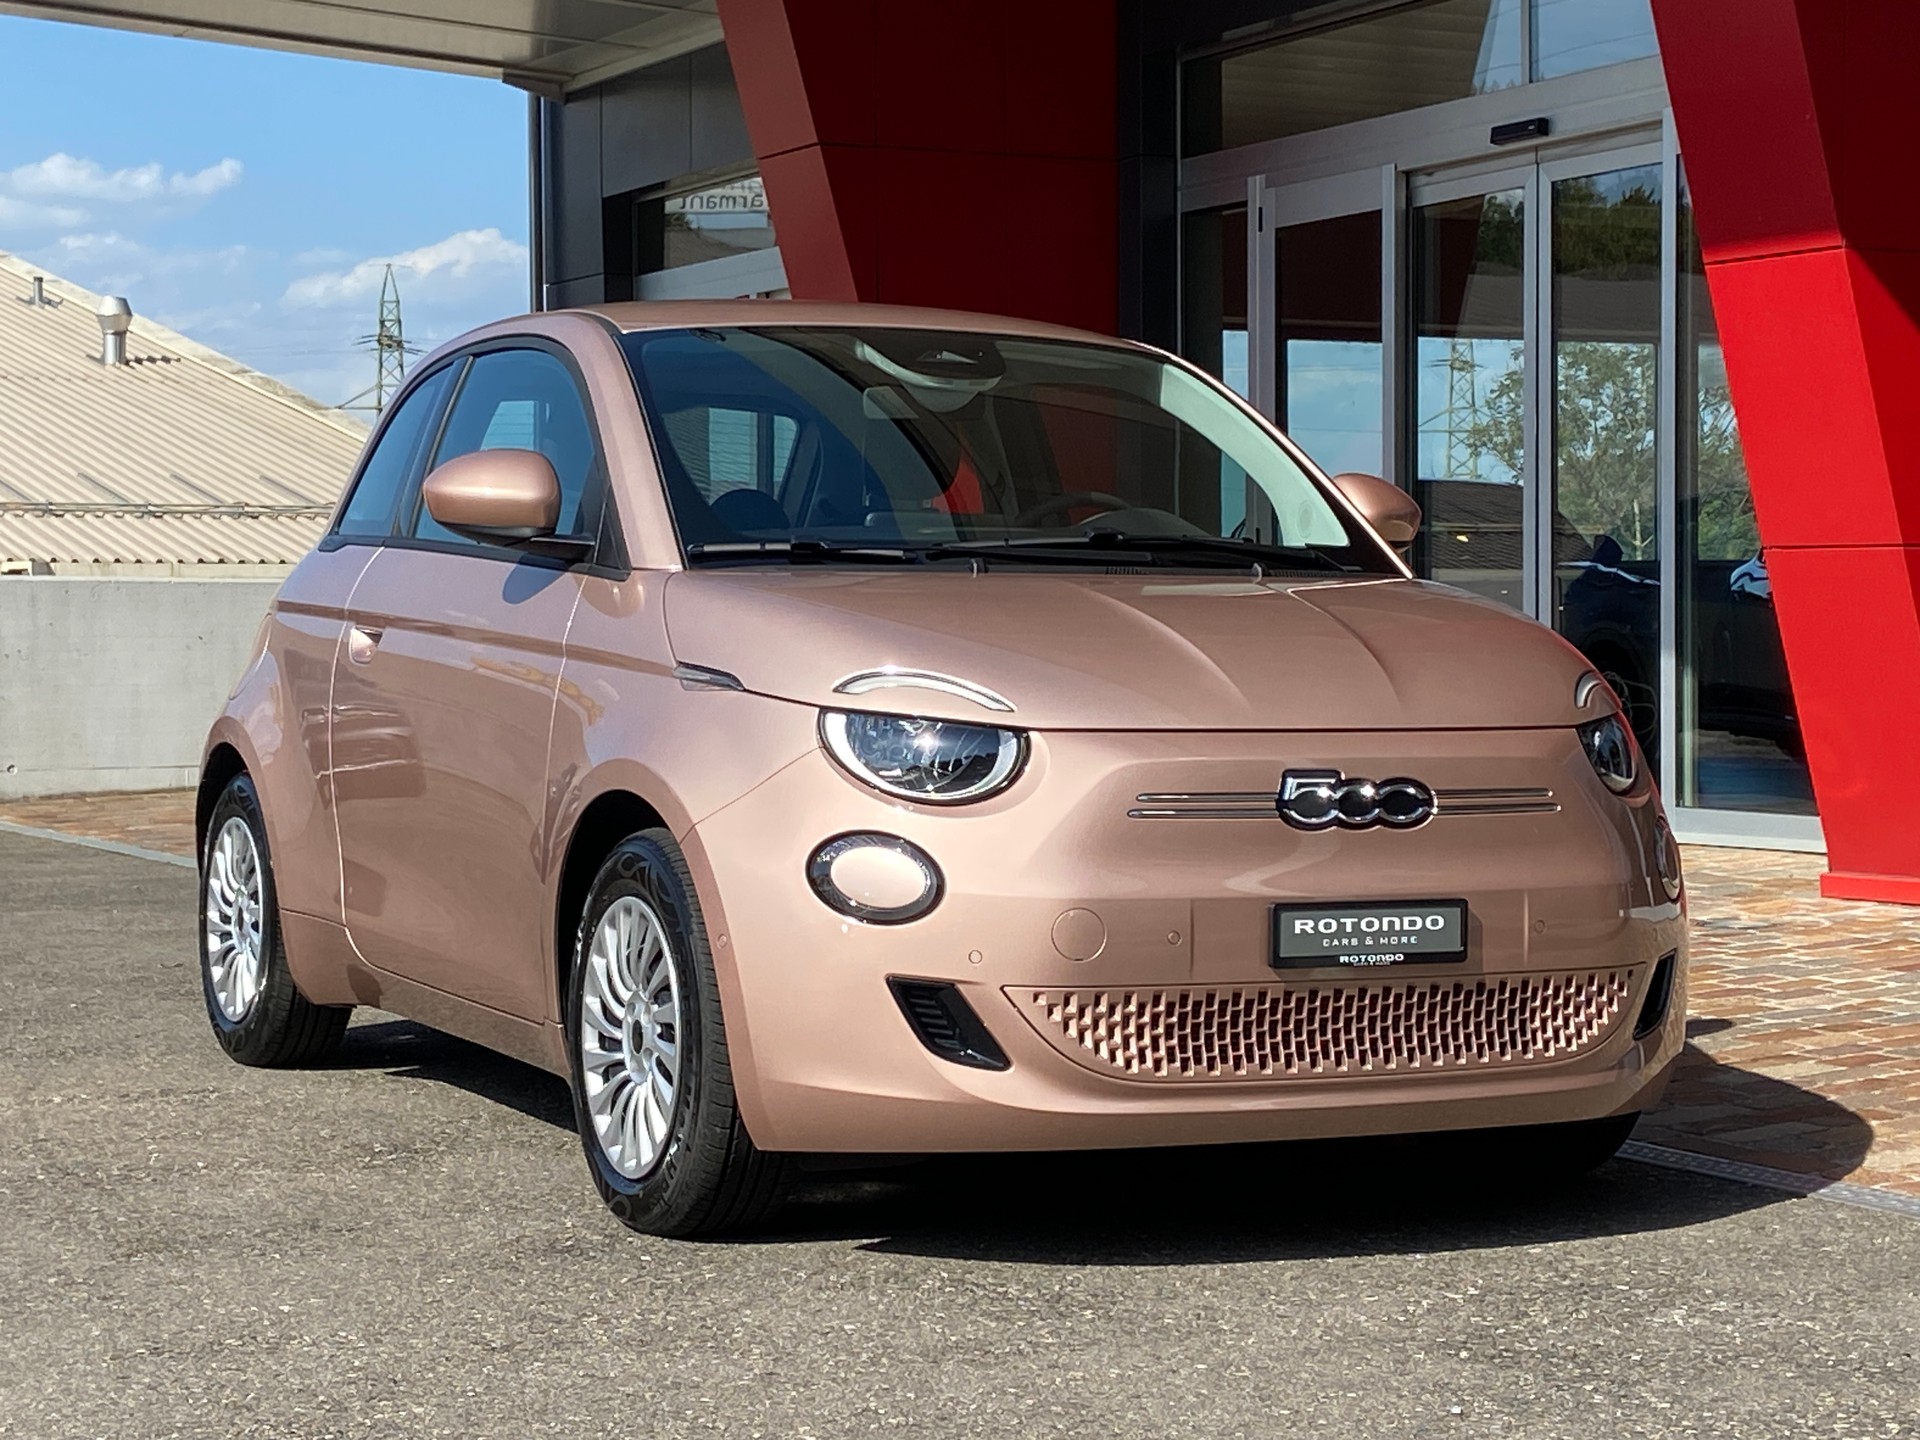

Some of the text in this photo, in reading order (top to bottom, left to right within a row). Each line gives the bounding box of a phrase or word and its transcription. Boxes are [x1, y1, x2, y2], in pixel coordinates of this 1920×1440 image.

[1277, 769, 1435, 831] 500
[1294, 915, 1445, 934] ROTONDO
[1322, 935, 1418, 947] CARS & MORE
[1339, 953, 1405, 963] ROTONDO
